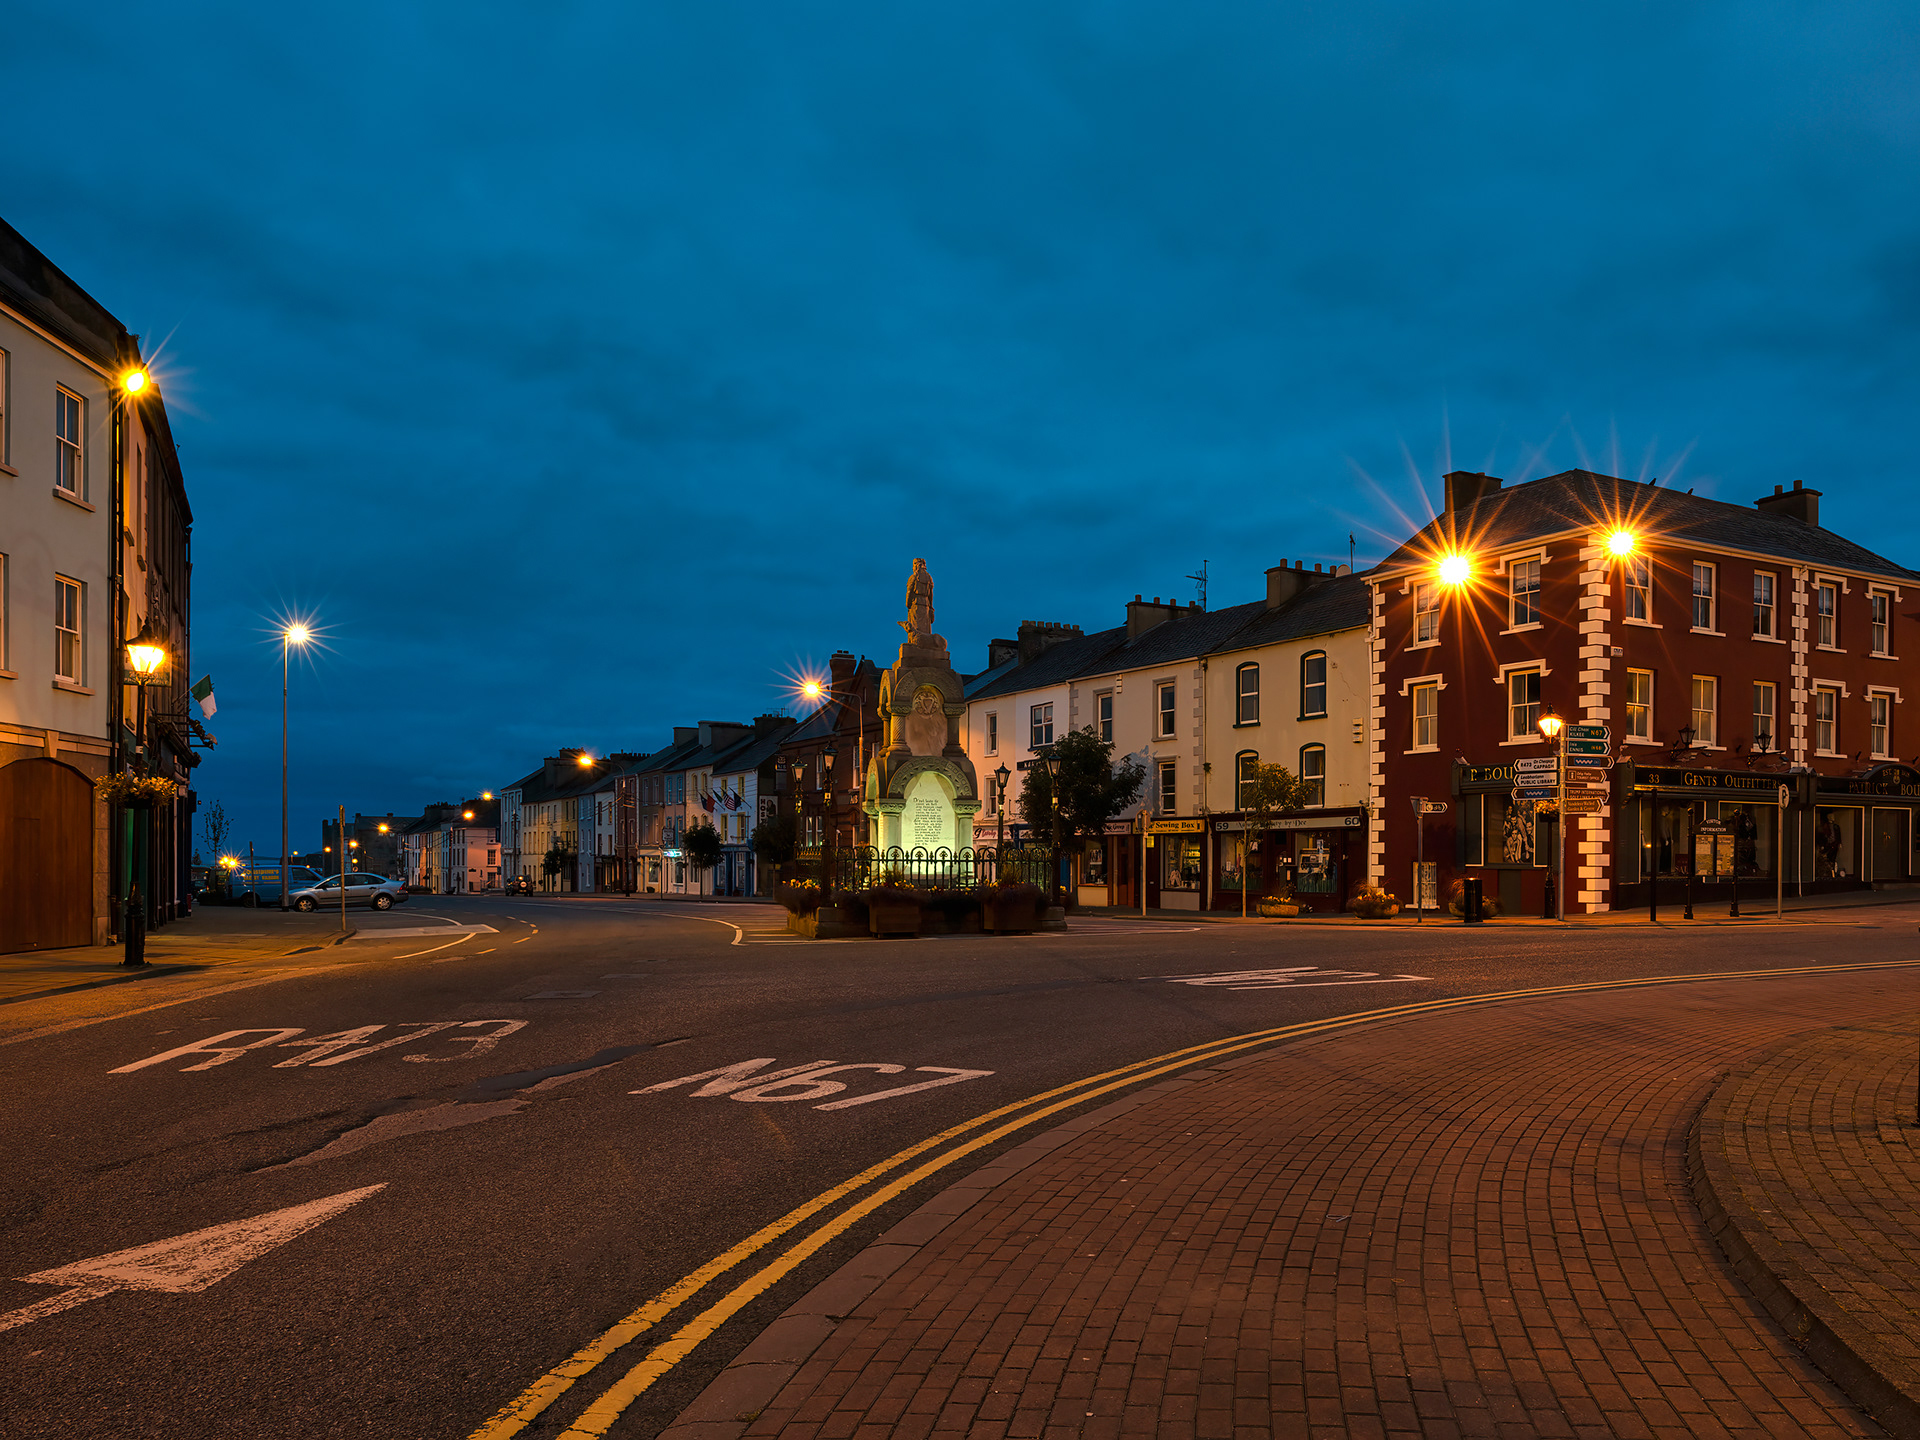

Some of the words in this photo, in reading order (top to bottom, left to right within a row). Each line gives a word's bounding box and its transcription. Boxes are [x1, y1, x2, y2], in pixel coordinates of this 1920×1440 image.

[1648, 773, 1660, 784] 33
[1684, 771, 1717, 787] GENTS
[1848, 781, 1889, 795] PATRICK
[1155, 821, 1180, 829] Sewing
[1181, 821, 1195, 829] Box
[1216, 822, 1229, 831] 59
[1344, 817, 1360, 826] 60
[106, 1018, 530, 1074] R473
[627, 1057, 997, 1112] N67
